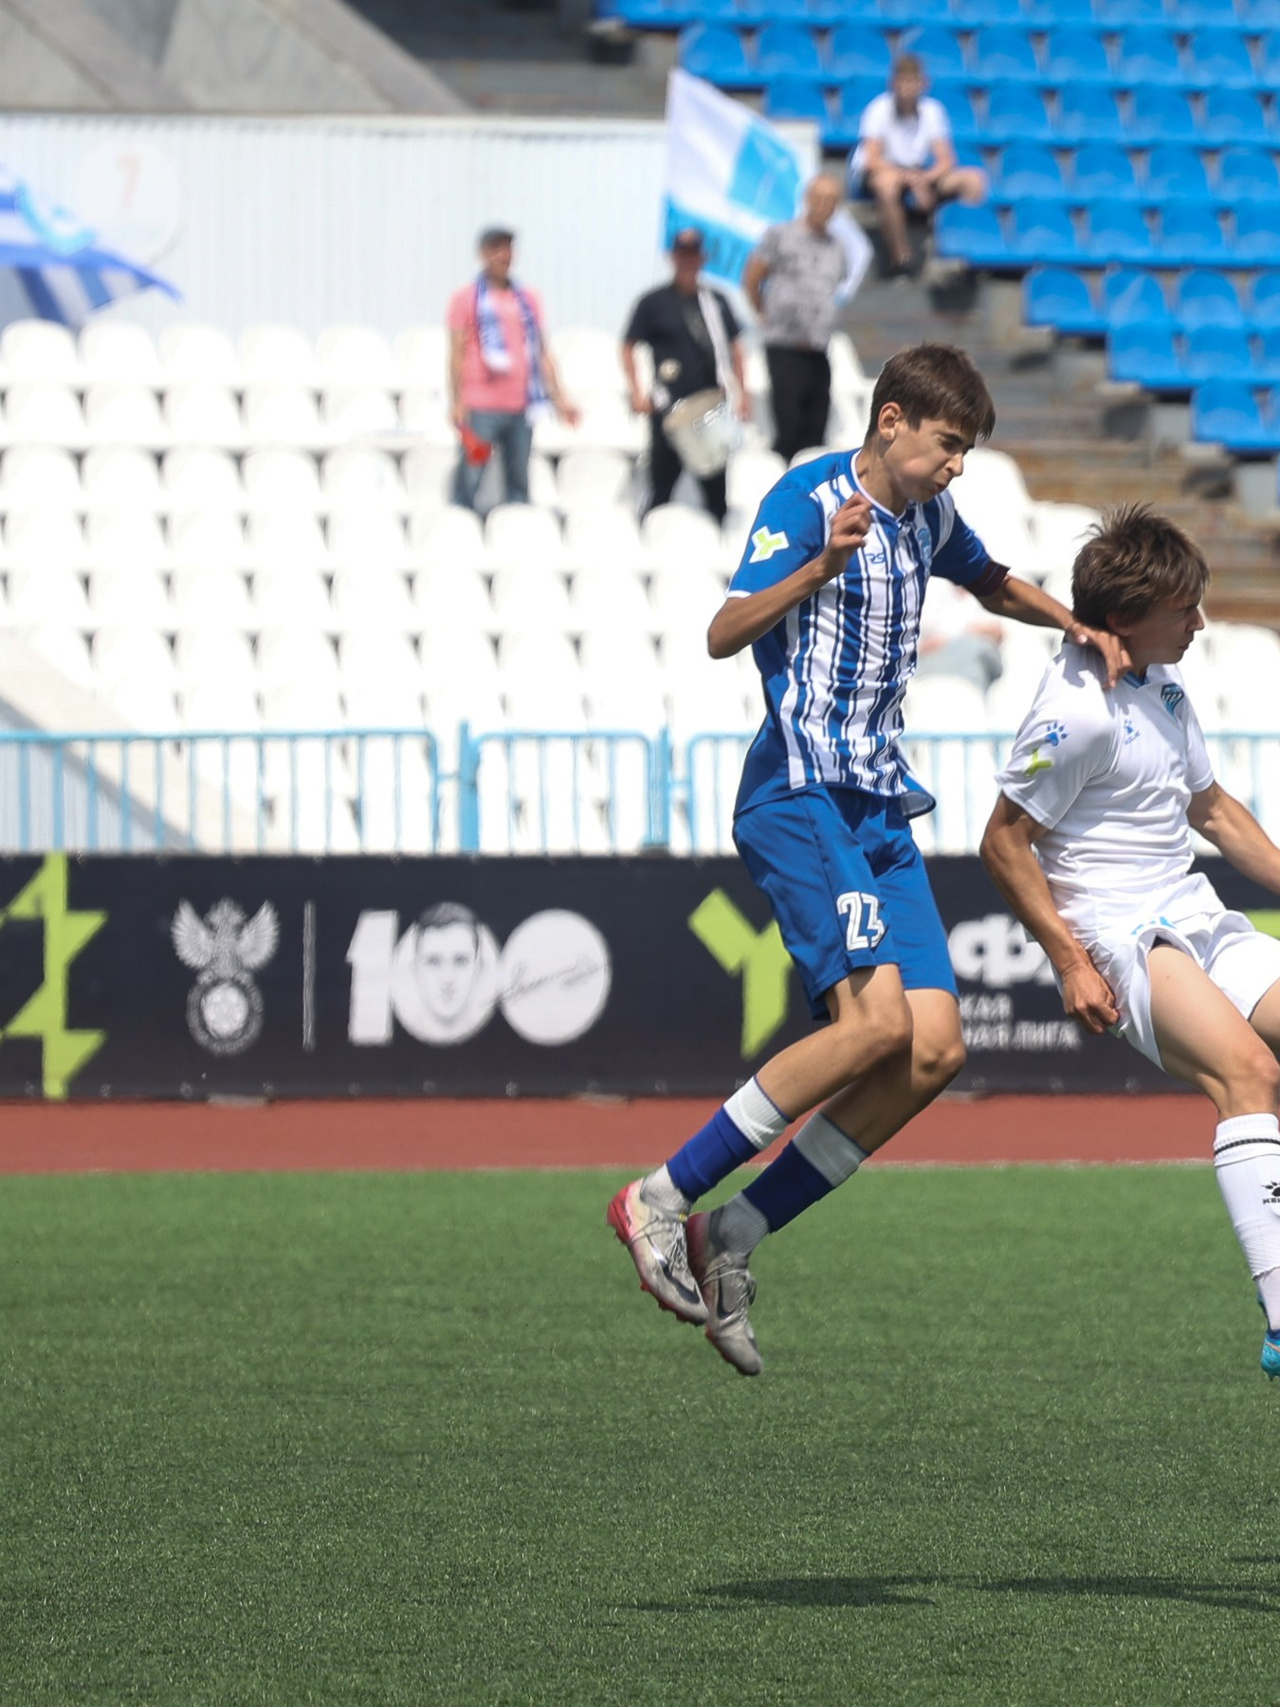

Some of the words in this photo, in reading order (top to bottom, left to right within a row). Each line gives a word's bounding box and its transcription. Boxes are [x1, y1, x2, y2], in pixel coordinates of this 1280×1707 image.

[836, 891, 885, 951] 23
[345, 902, 612, 1046] 100
[1013, 1020, 1081, 1050] ЛИГА
